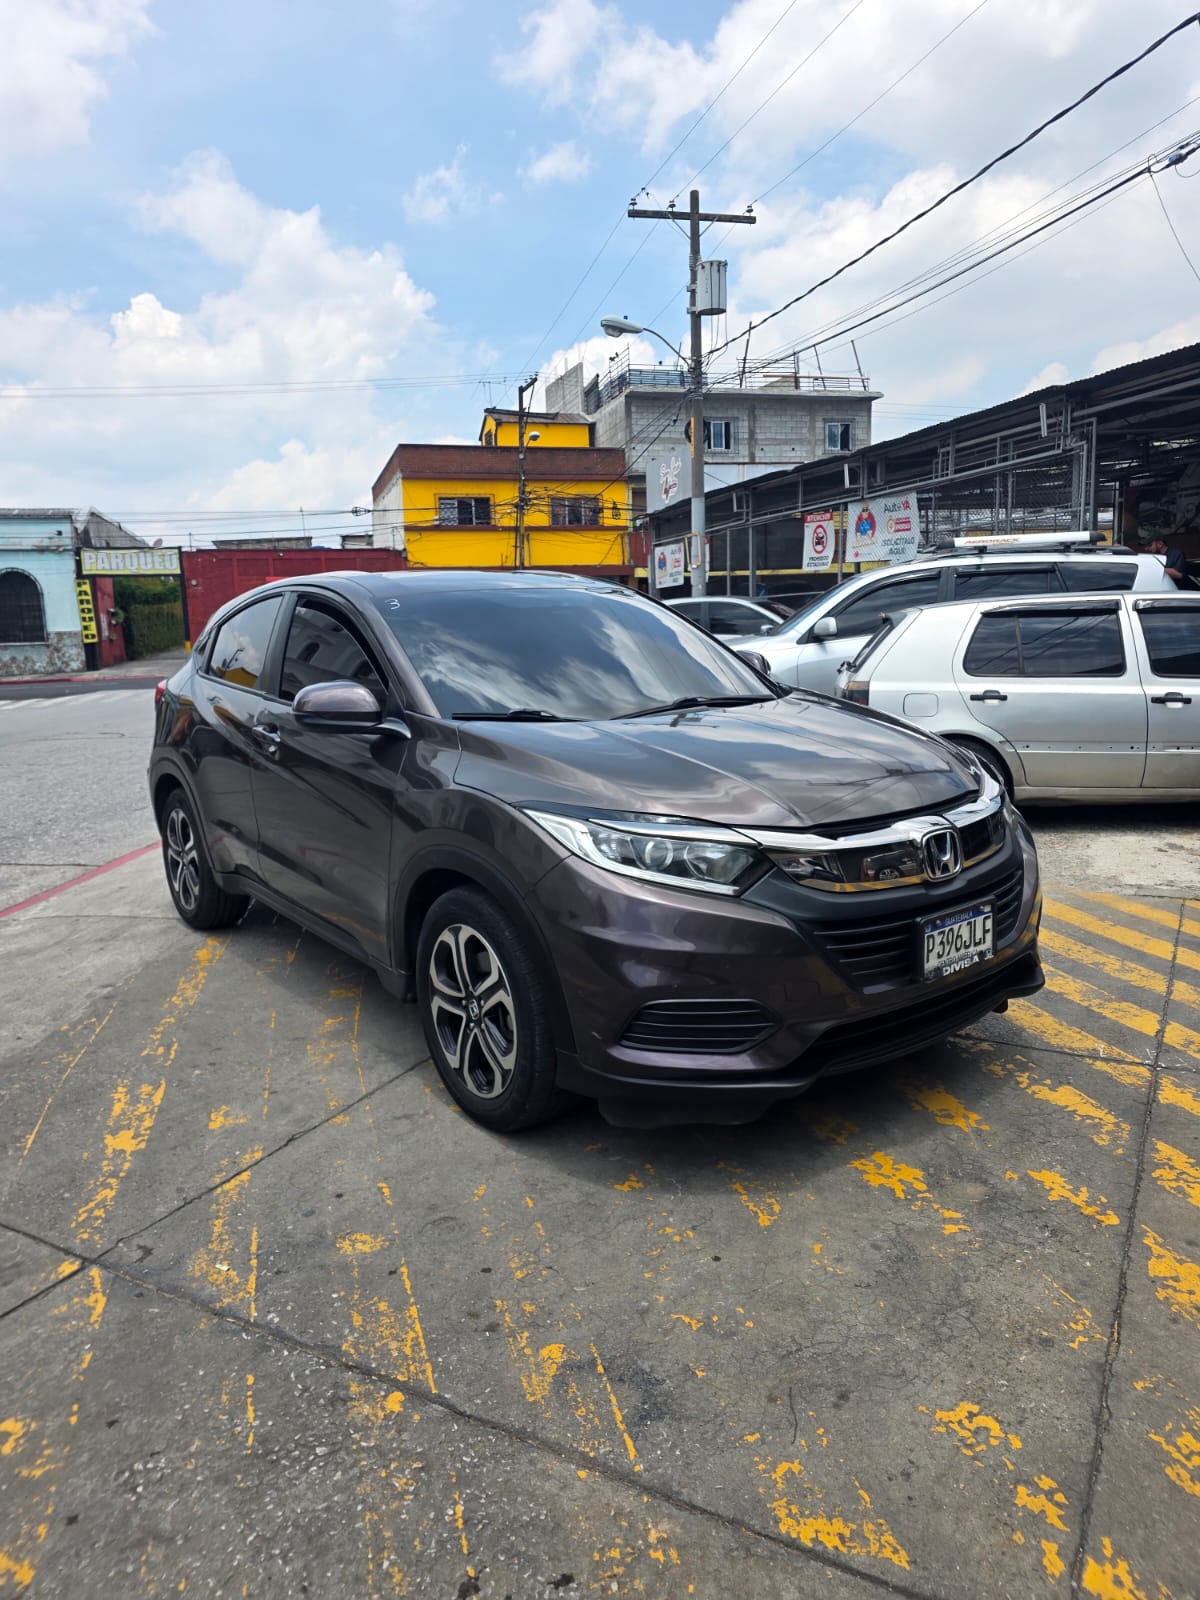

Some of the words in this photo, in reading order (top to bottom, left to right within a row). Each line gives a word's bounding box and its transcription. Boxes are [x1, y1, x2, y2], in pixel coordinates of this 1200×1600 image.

[83, 551, 178, 573] PARQUEO
[77, 581, 97, 640] PARQUEO
[384, 598, 400, 610] 3
[926, 914, 992, 964] P396JLF
[942, 955, 980, 977] DIVISA
